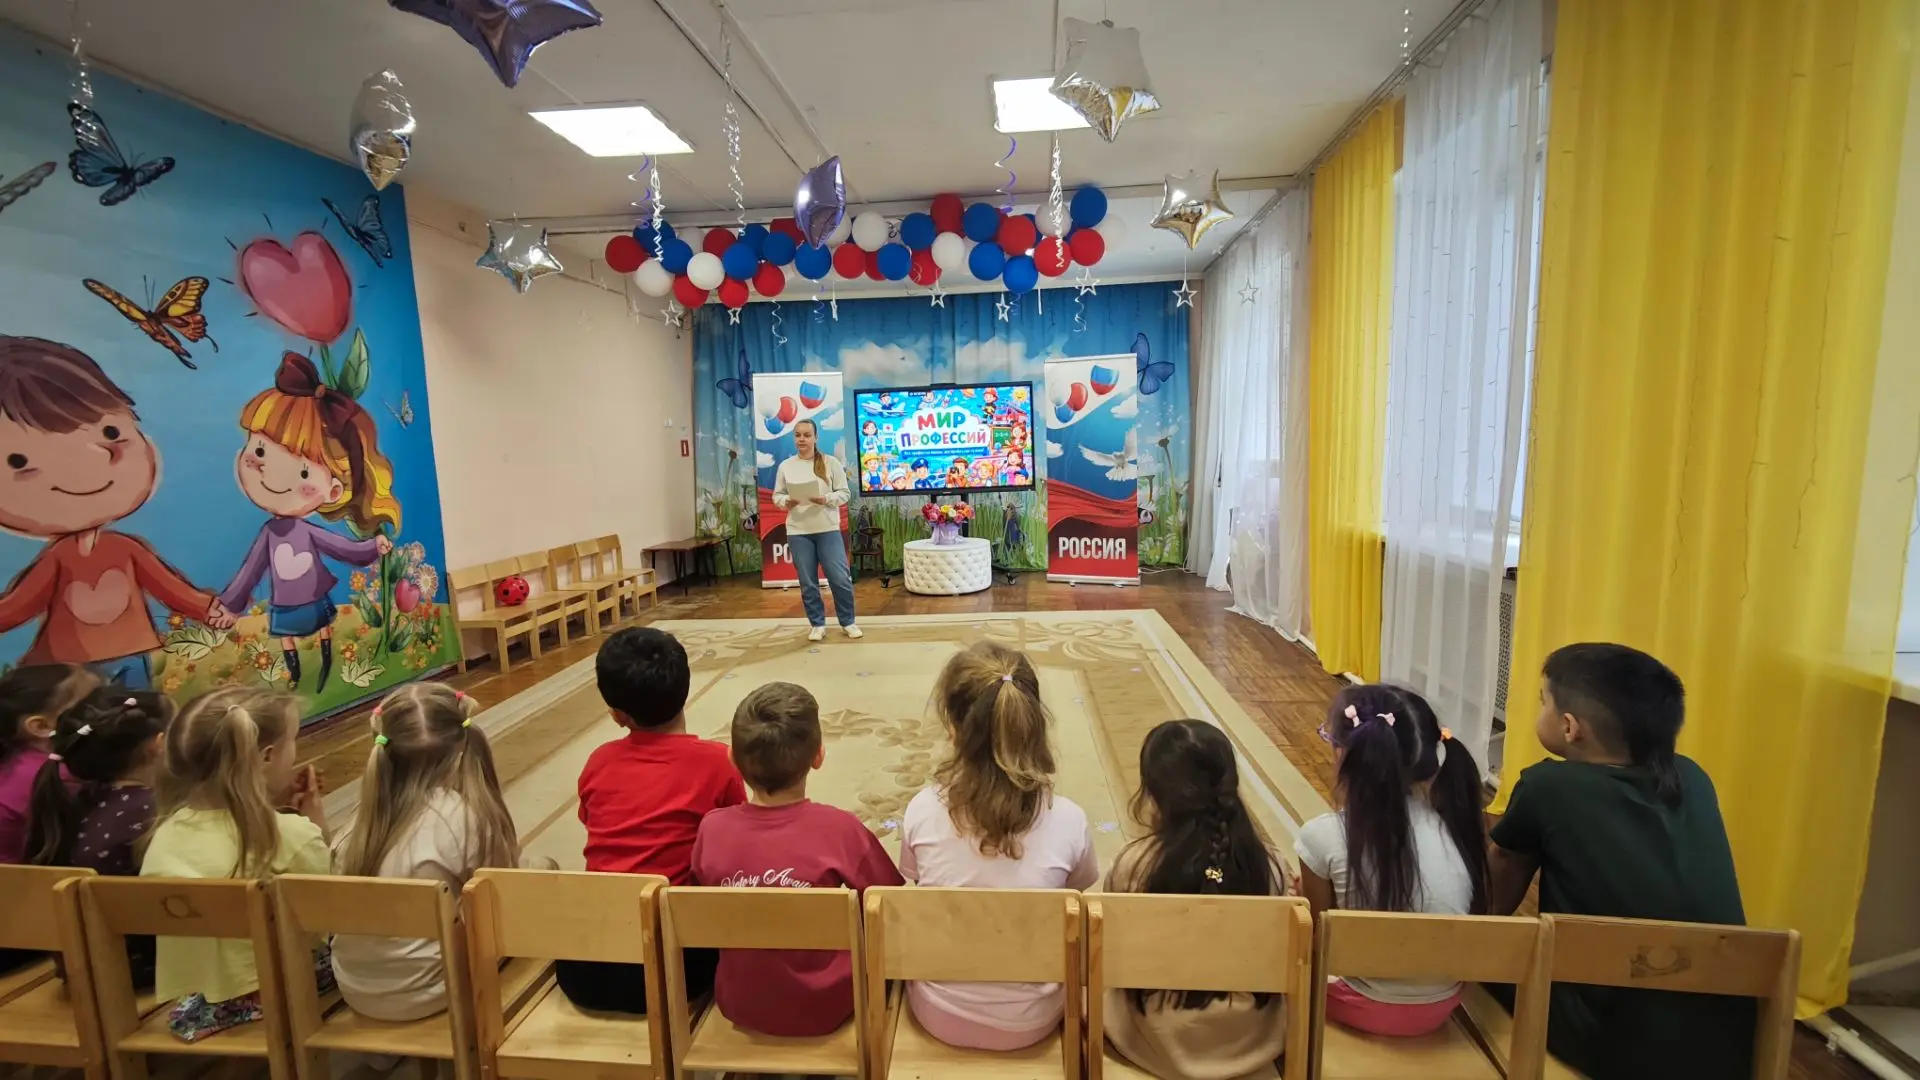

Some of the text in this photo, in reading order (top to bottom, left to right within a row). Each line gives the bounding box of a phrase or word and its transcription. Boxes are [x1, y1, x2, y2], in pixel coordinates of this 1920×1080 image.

[917, 411, 966, 431] МИР
[901, 428, 986, 447] ПРОФЕССИЙ
[1058, 536, 1127, 560] РОССИЯ
